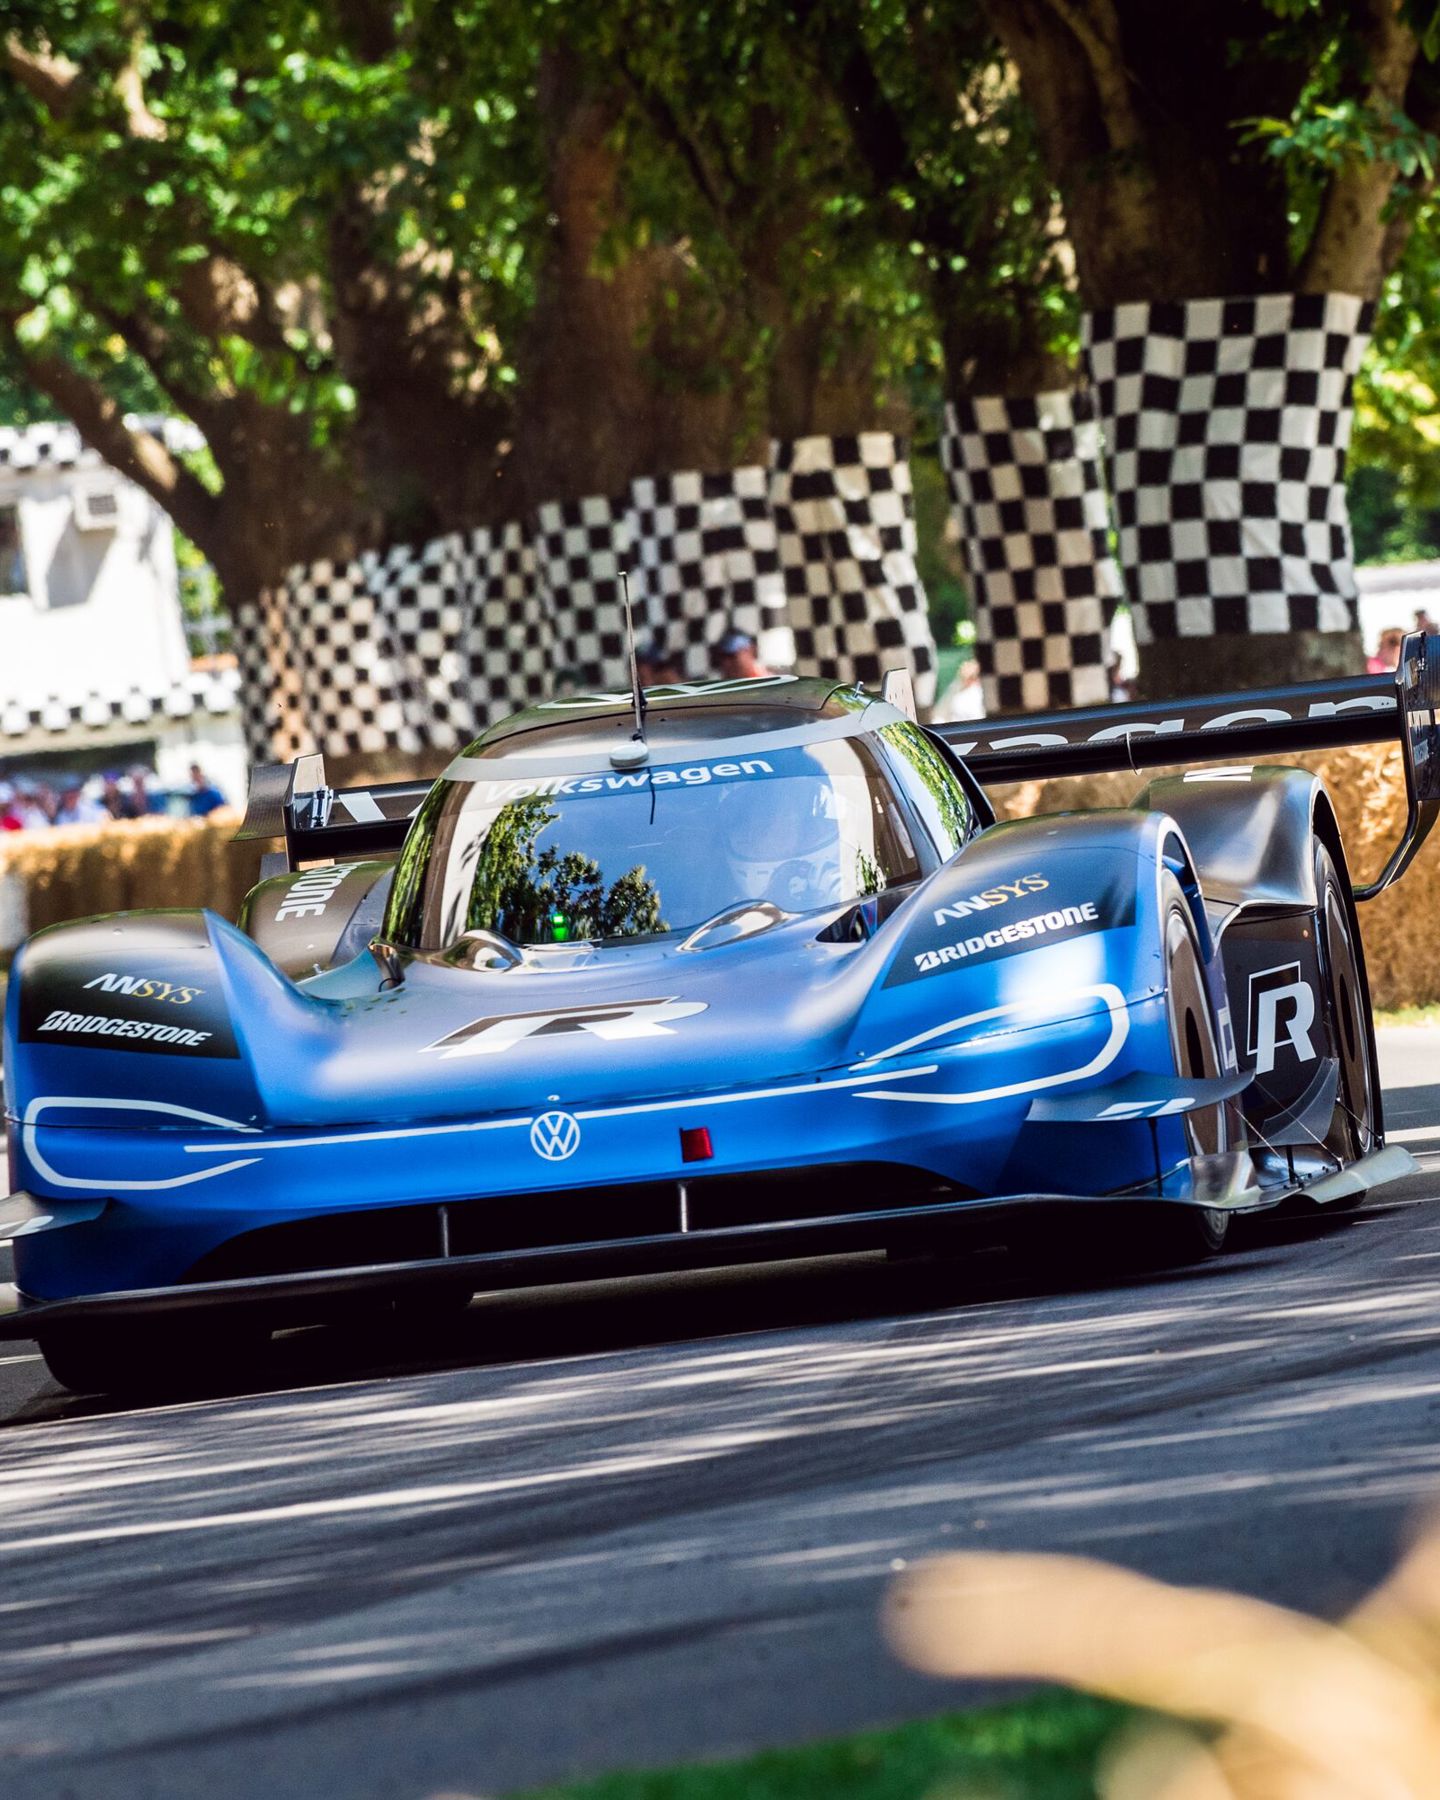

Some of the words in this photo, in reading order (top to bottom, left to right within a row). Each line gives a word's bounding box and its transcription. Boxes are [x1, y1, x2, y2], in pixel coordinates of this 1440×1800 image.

[482, 757, 775, 804] Volkswagen
[933, 872, 1050, 927] ANSYS
[913, 901, 1099, 972] BRIDGESTONE
[82, 973, 206, 1005] ANSYS
[36, 1010, 213, 1047] BRIDGESTONE
[1255, 980, 1317, 1075] R
